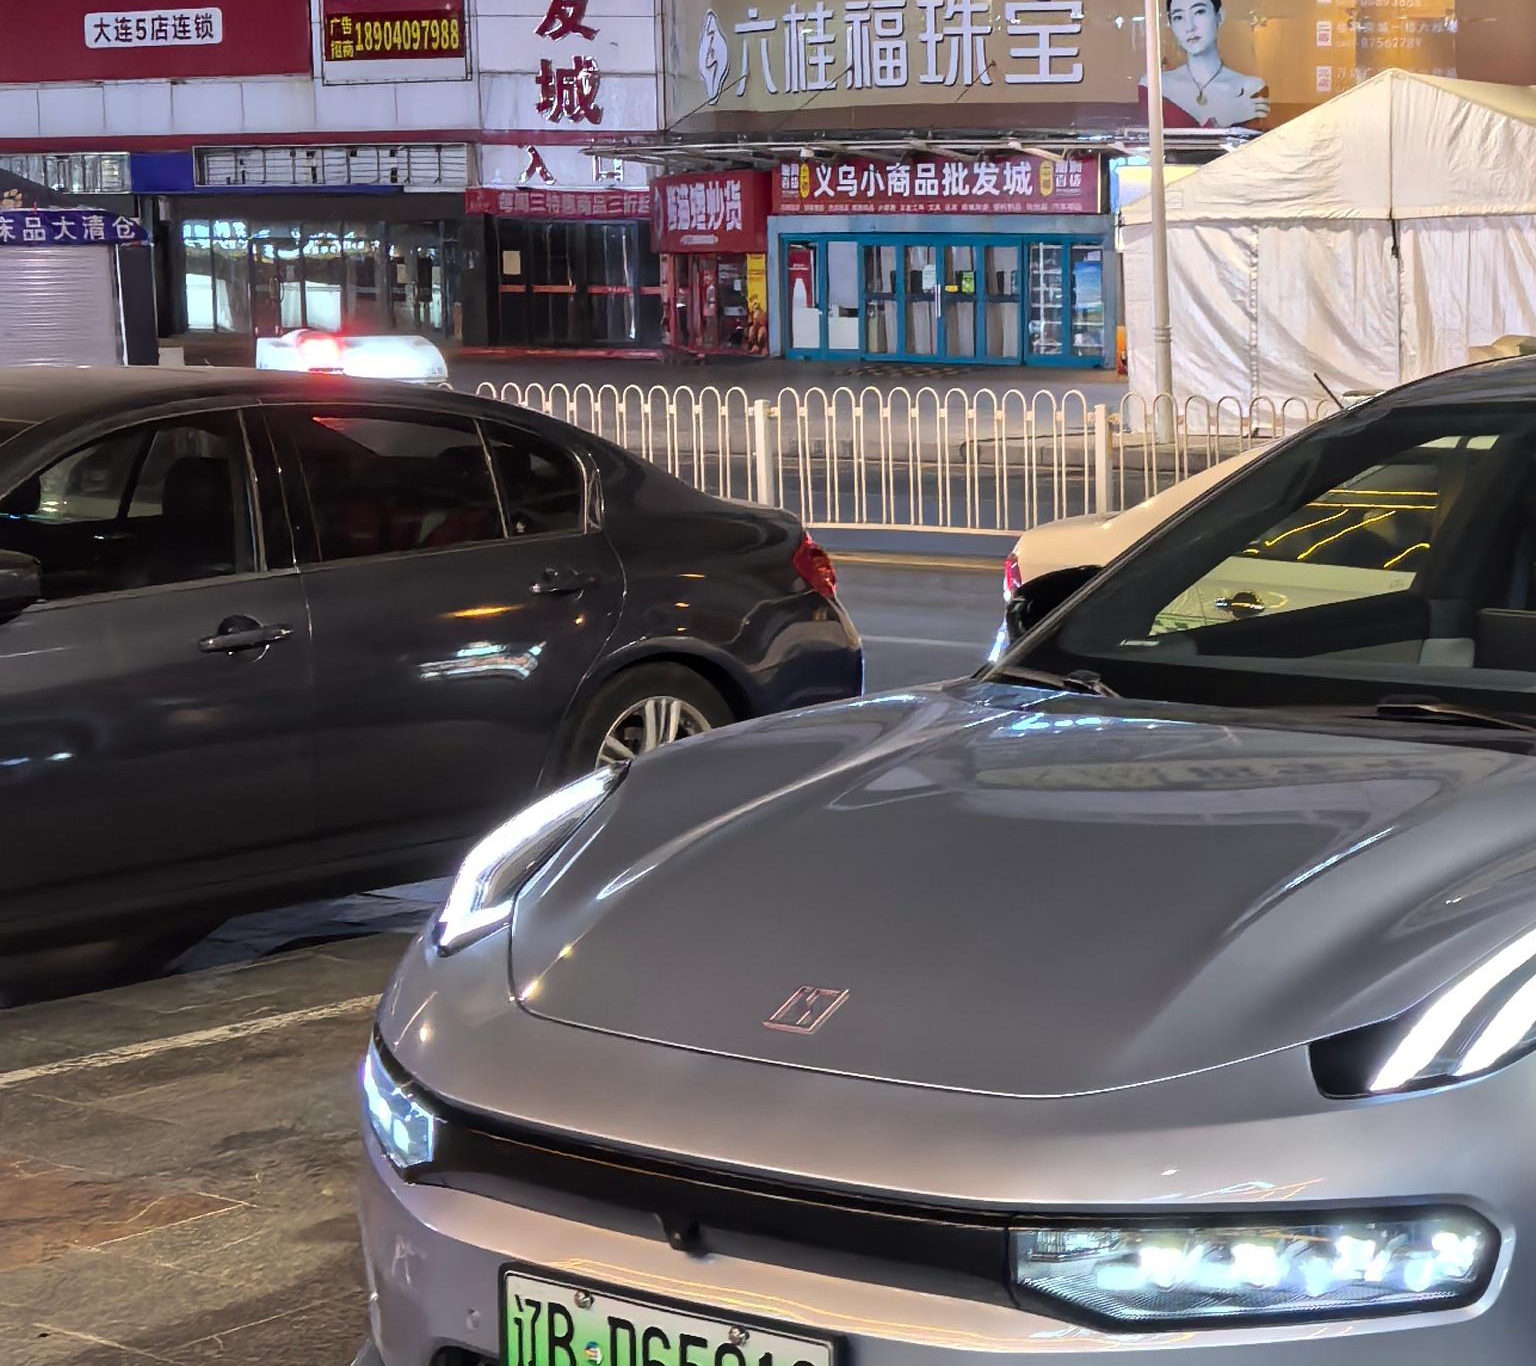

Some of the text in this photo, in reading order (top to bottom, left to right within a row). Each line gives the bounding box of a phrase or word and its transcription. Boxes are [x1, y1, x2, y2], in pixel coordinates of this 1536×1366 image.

[93, 13, 215, 44] 大连5店连锁
[330, 16, 353, 35] 广告
[355, 19, 460, 51] 18904097988
[814, 161, 1034, 198] 义乌小商品批发城
